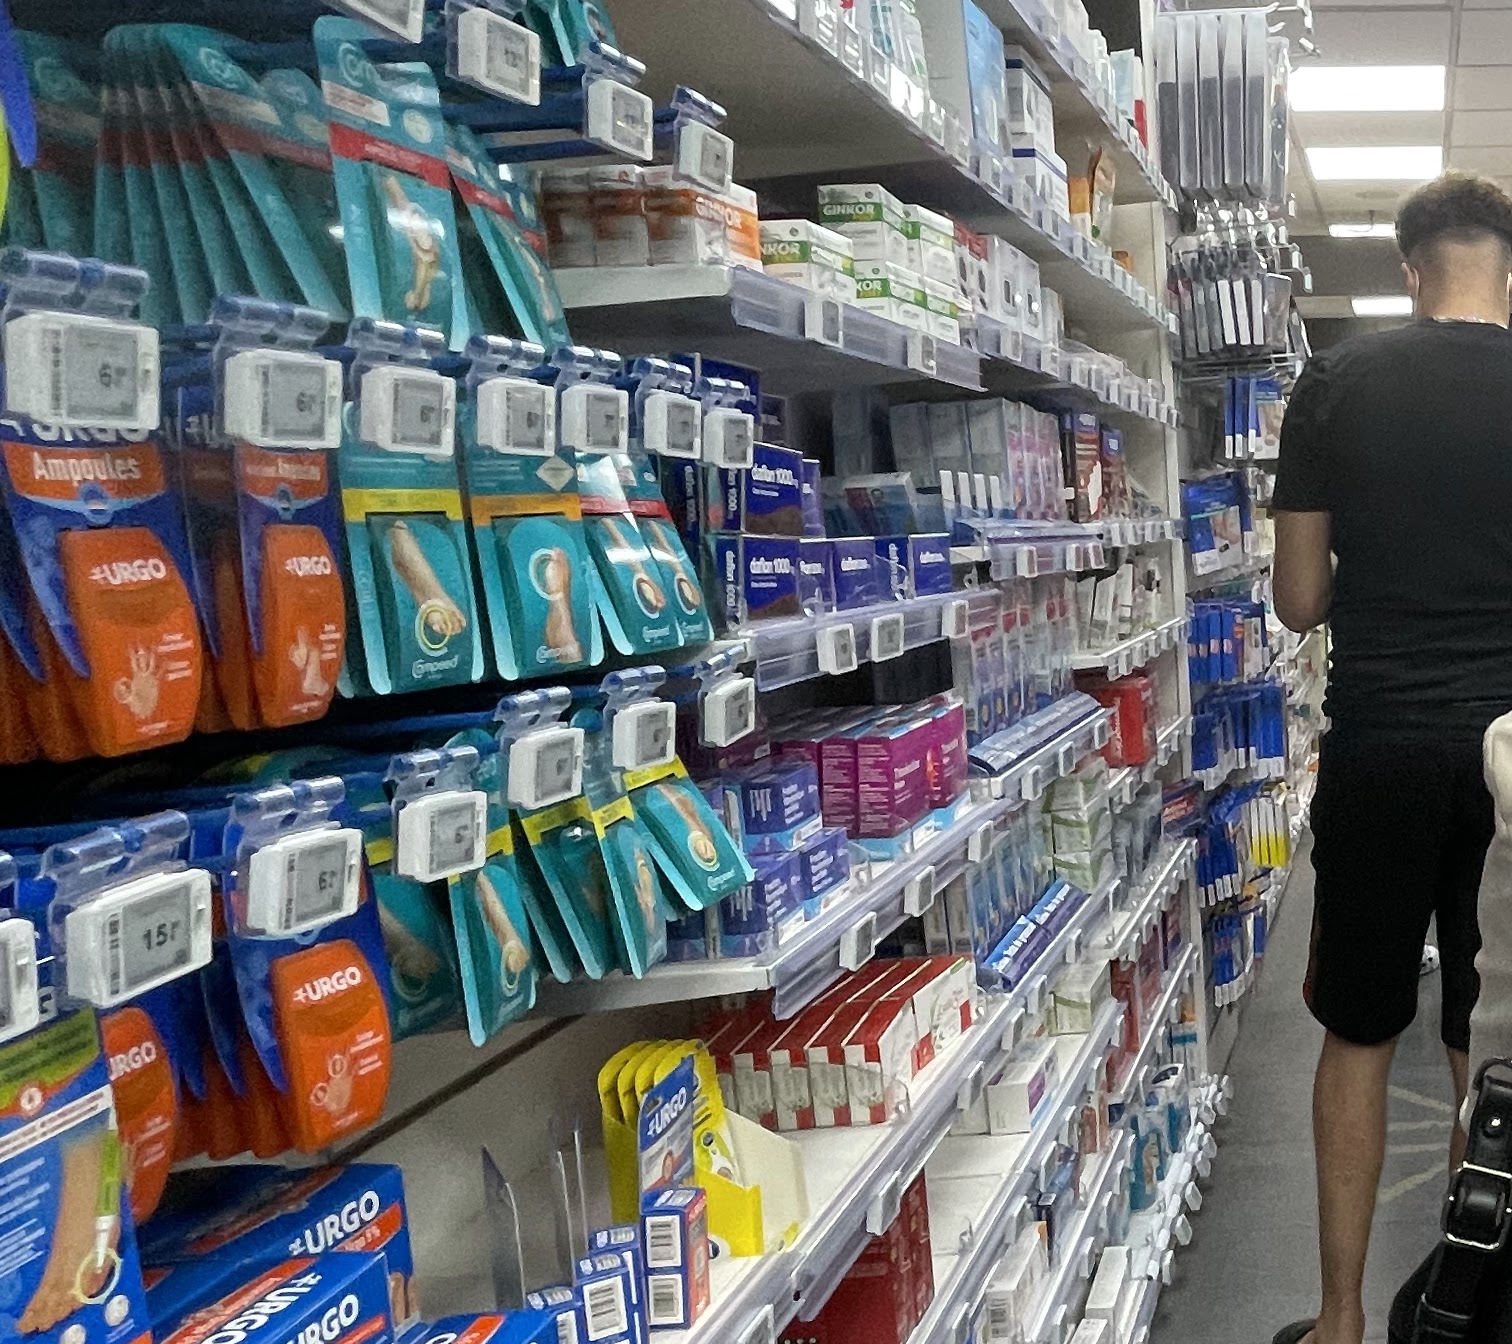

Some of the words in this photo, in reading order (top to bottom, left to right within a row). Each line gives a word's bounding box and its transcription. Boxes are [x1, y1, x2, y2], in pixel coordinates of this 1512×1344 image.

[823, 203, 875, 217] GINKOR
[33, 451, 141, 488] Ampoules
[107, 558, 167, 586] URGO
[296, 555, 331, 577] URGO
[308, 966, 362, 1002] URGO
[654, 1086, 687, 1136] URGO
[304, 1190, 380, 1256] URGO
